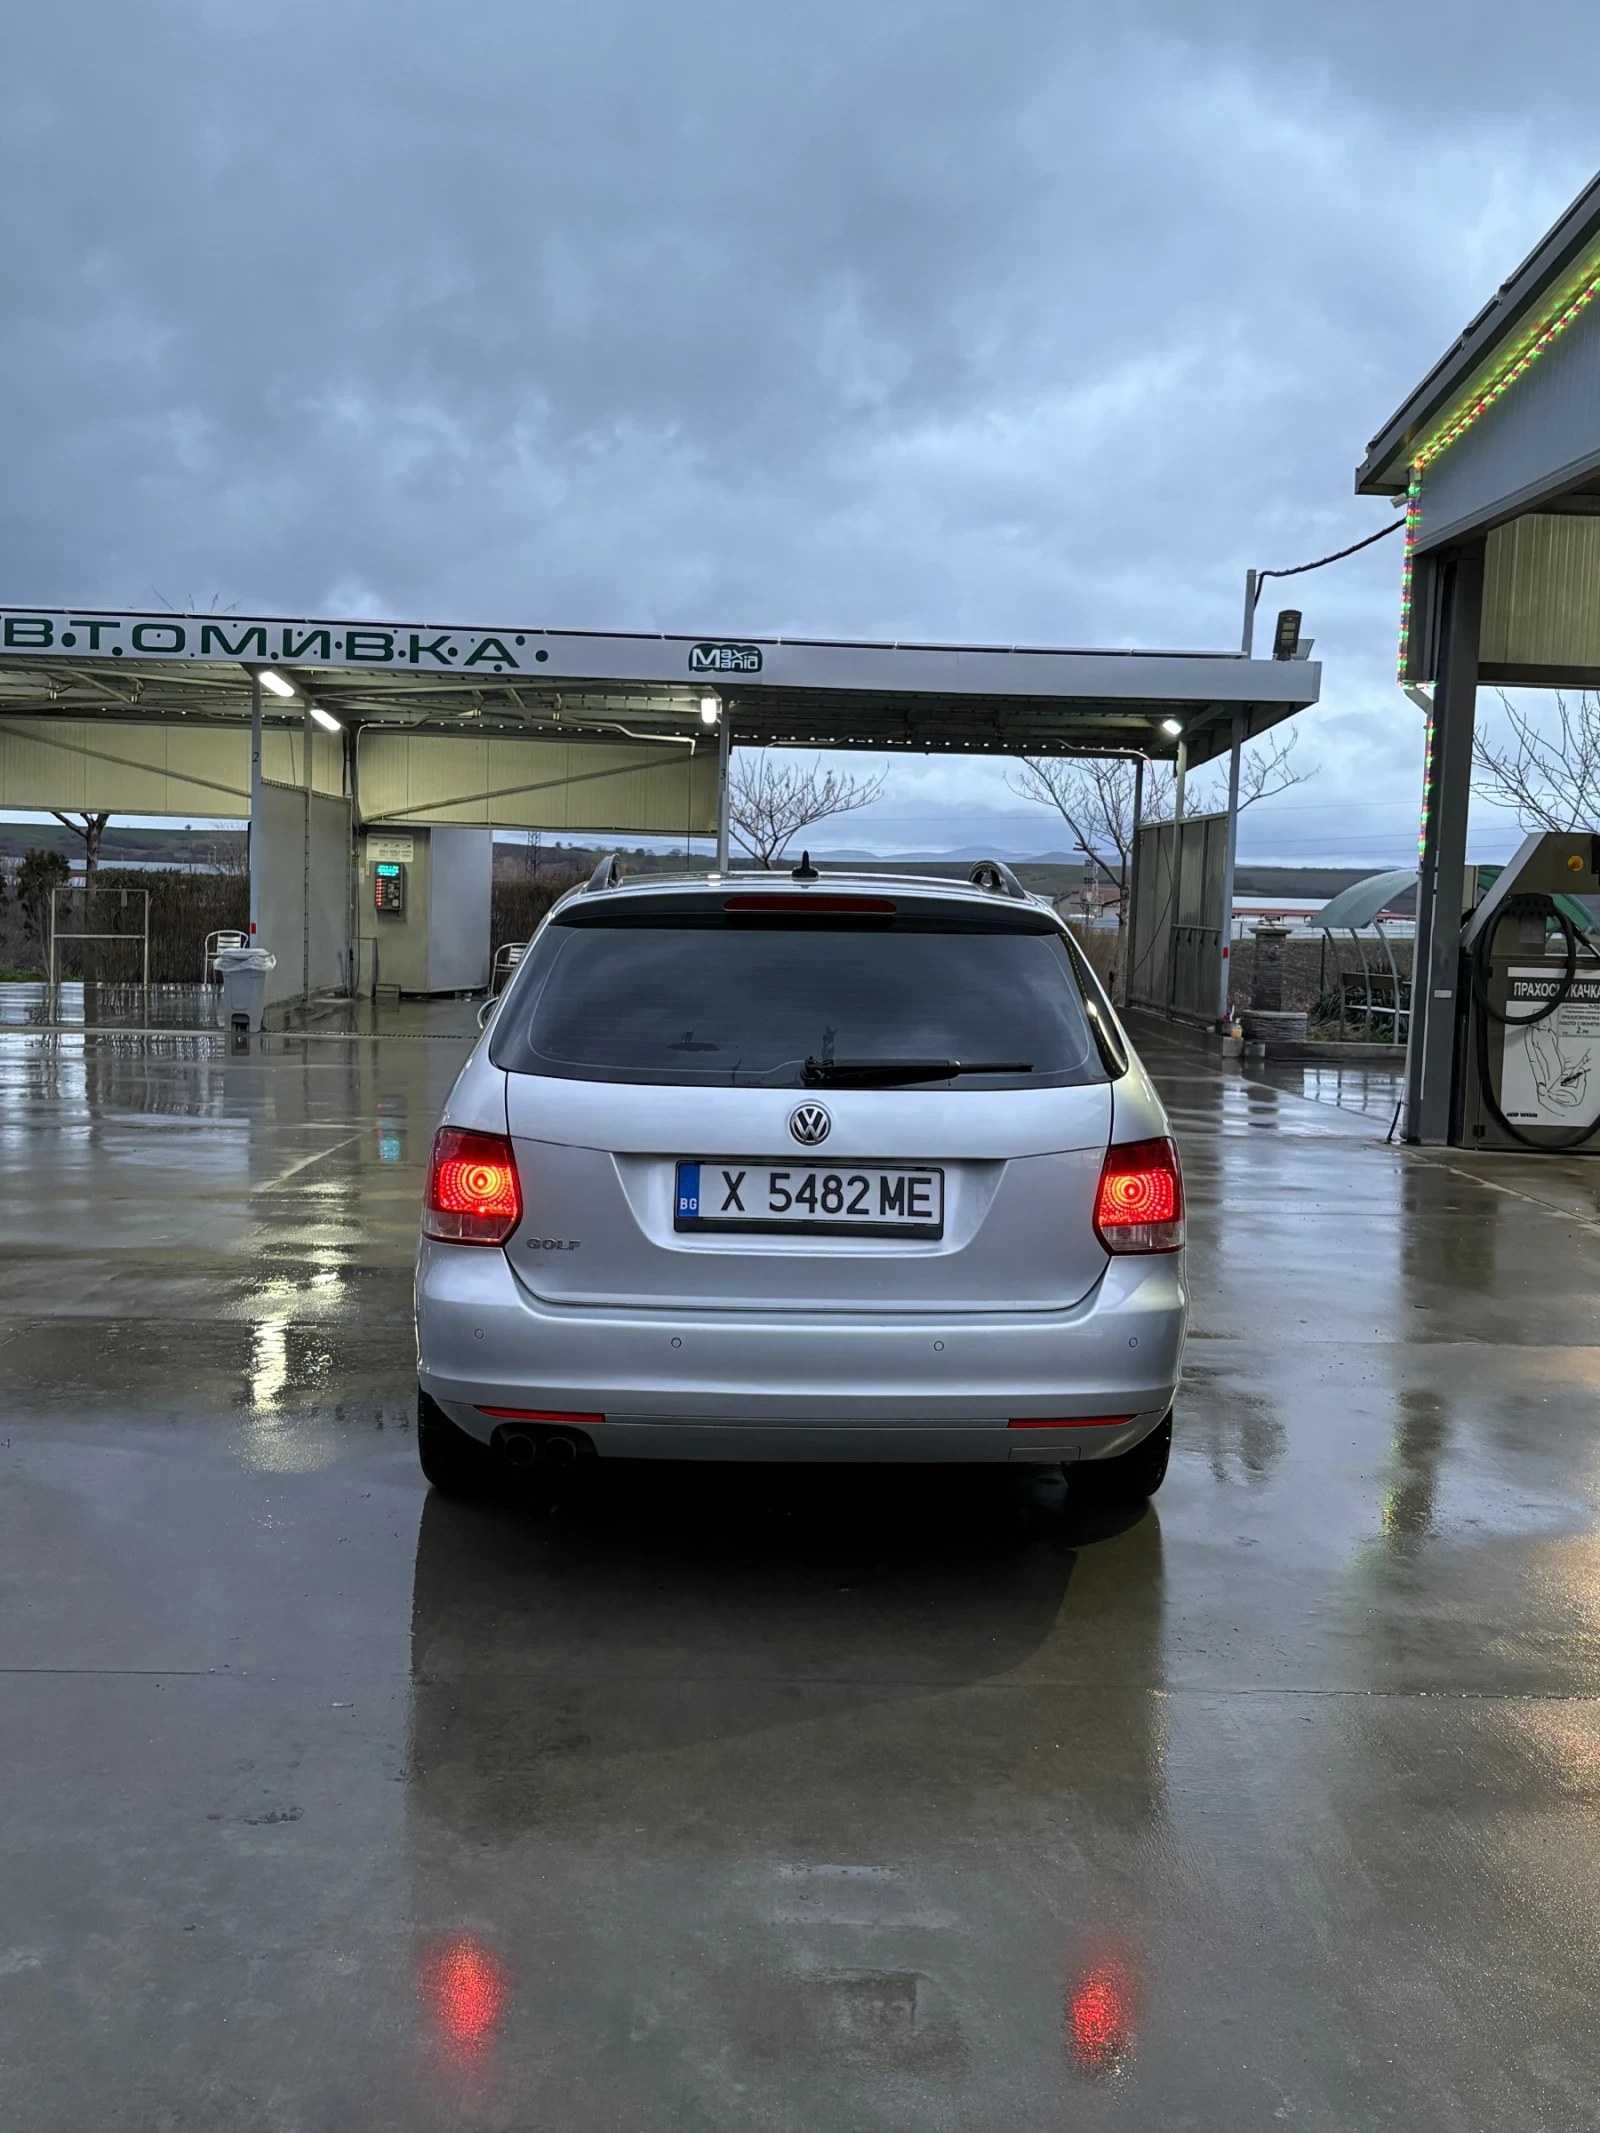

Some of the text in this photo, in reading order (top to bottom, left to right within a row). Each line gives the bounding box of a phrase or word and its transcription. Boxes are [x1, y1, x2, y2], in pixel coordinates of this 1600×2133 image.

[252, 751, 260, 763] 2
[1576, 1026, 1582, 1034] 2
[679, 1171, 933, 1218] BG X 5482 ME
[526, 1237, 581, 1250] GOLF
